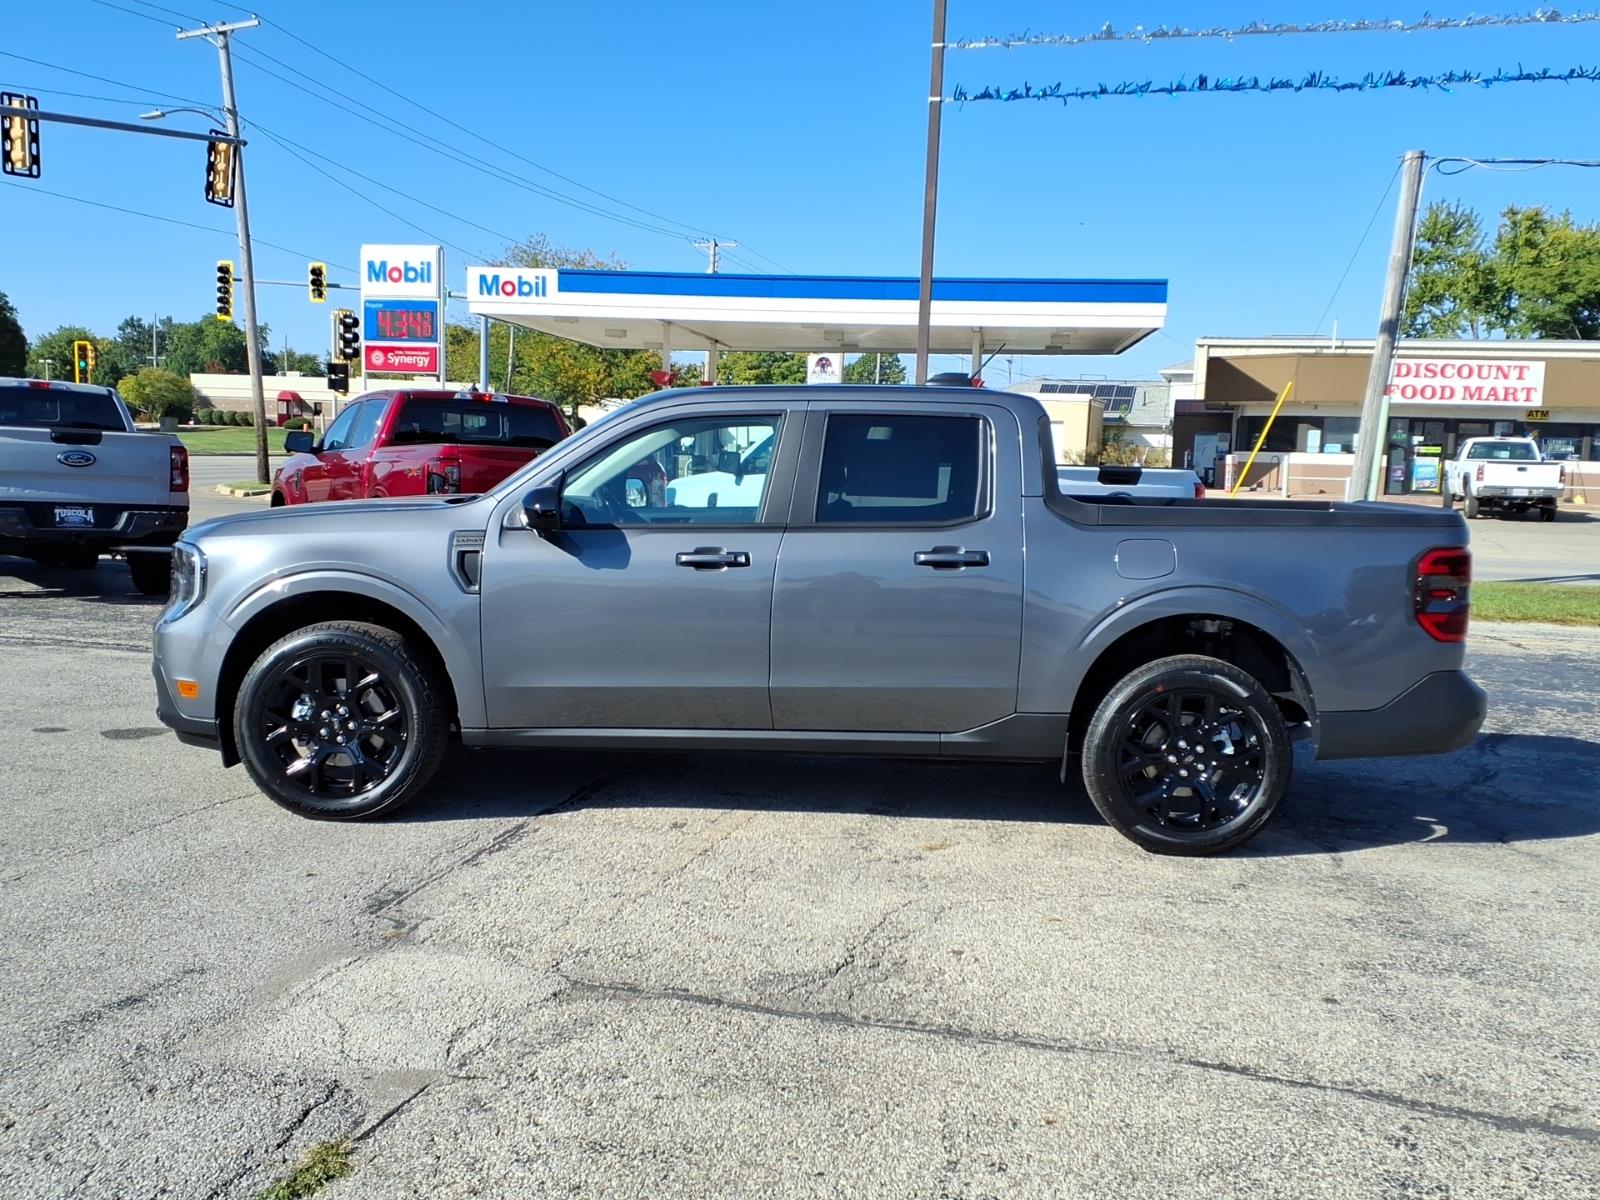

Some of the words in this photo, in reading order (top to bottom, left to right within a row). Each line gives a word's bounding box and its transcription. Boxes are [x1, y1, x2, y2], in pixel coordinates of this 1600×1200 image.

[367, 260, 432, 283] Mobil
[479, 274, 547, 298] Mobil
[387, 352, 431, 367] Synergy
[1394, 362, 1530, 380] DISCOUNT
[1383, 384, 1456, 400] FOOD
[1461, 385, 1537, 402] MART
[1527, 409, 1549, 418] ATM
[54, 508, 95, 523] TUSCOLA
